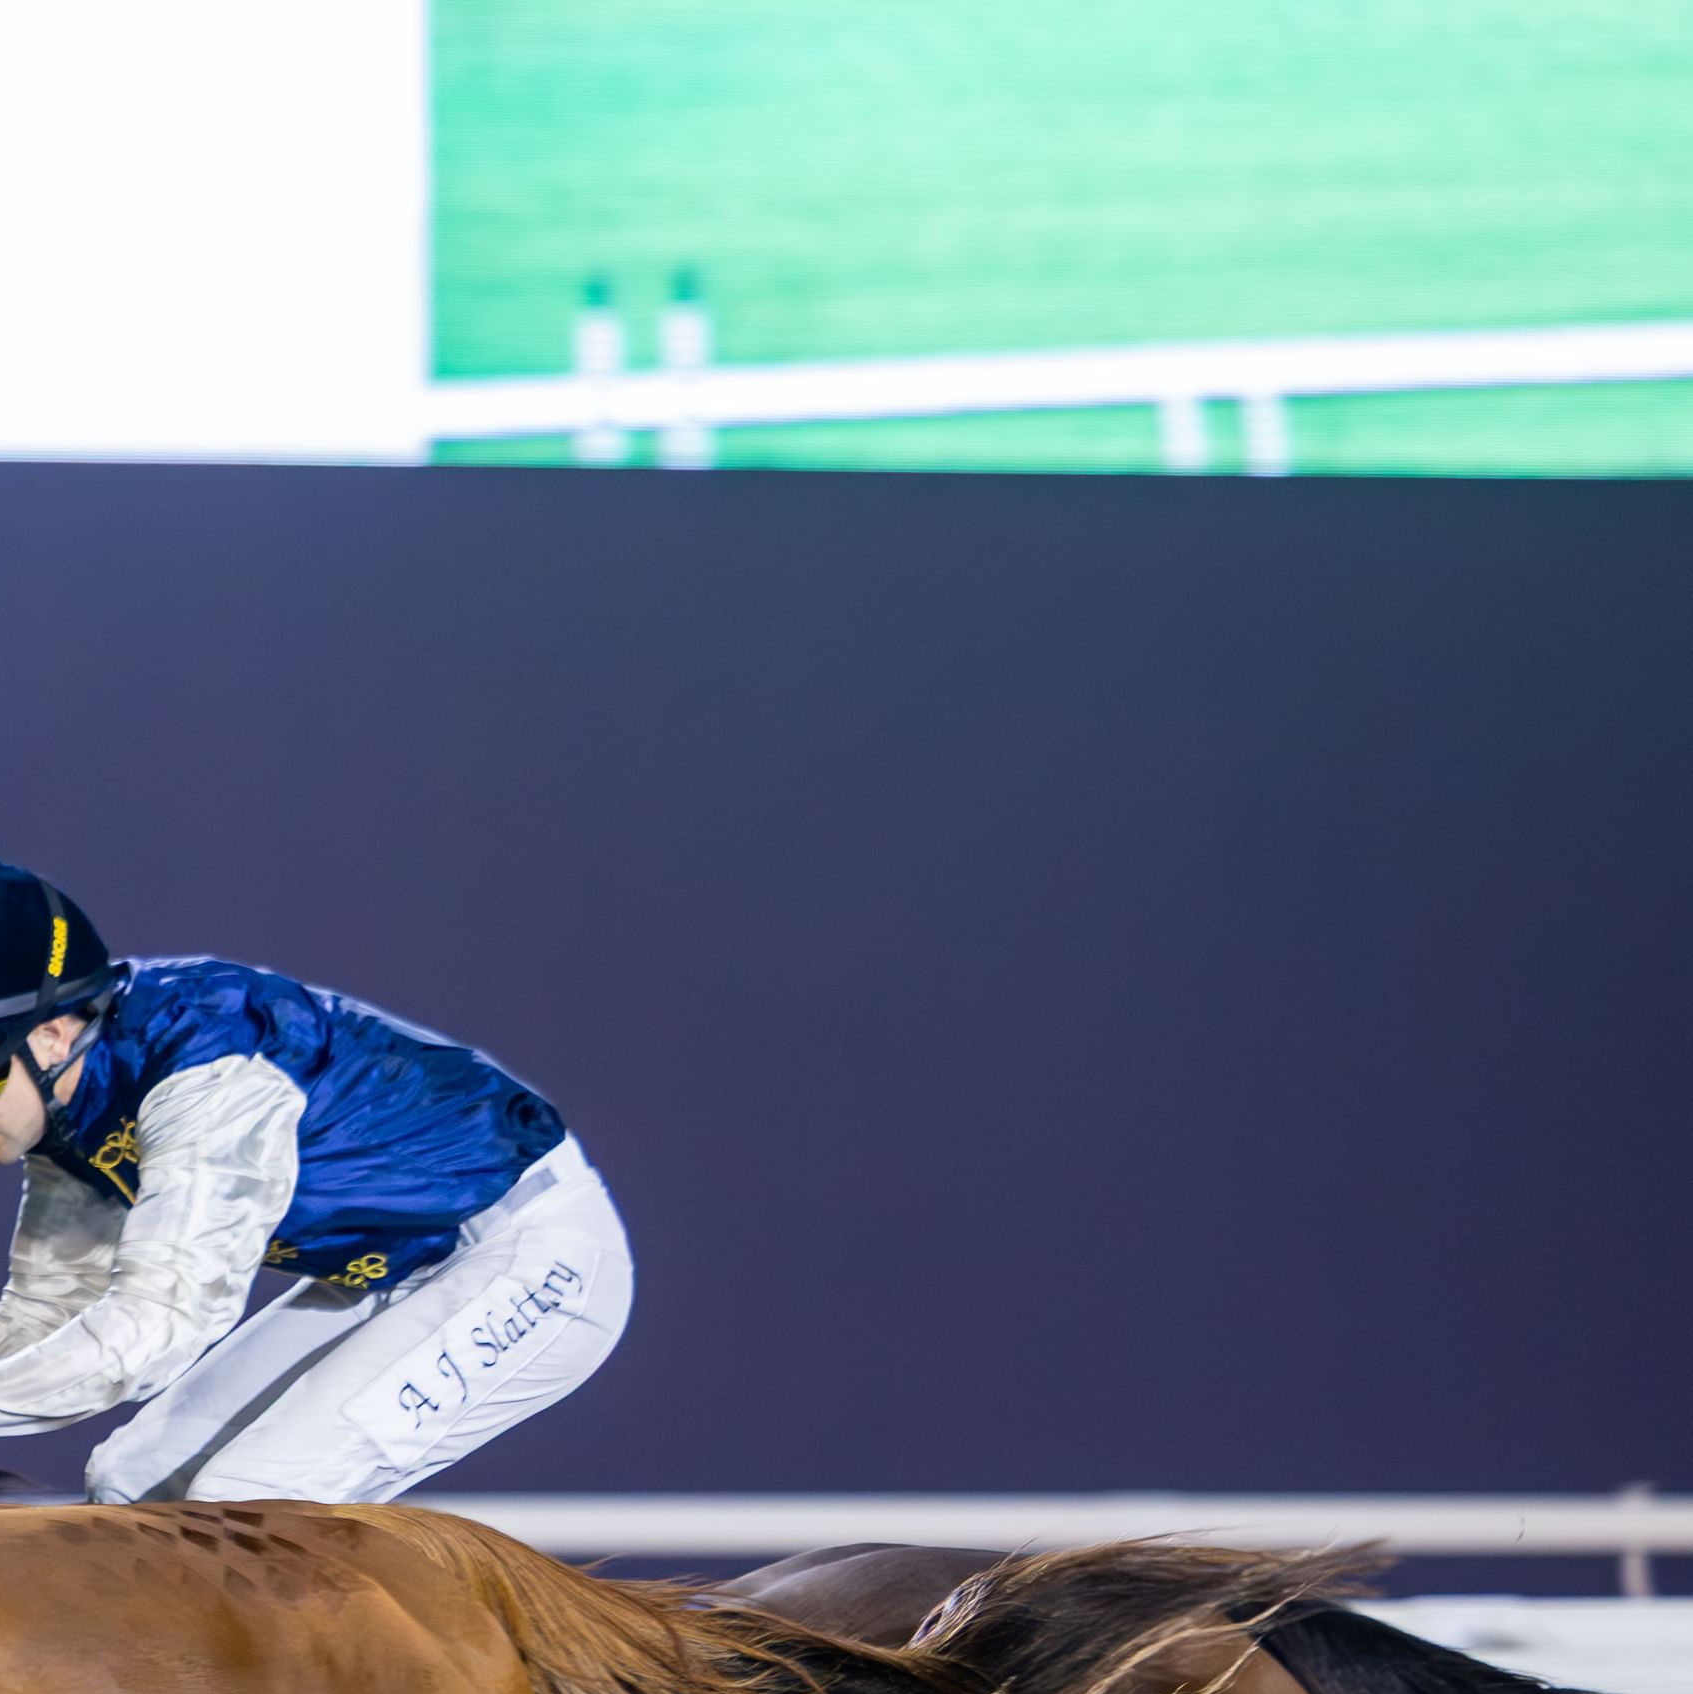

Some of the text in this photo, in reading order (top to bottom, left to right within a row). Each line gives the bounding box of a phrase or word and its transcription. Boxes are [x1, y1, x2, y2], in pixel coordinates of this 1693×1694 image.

[399, 1261, 583, 1430] A J Slattry
